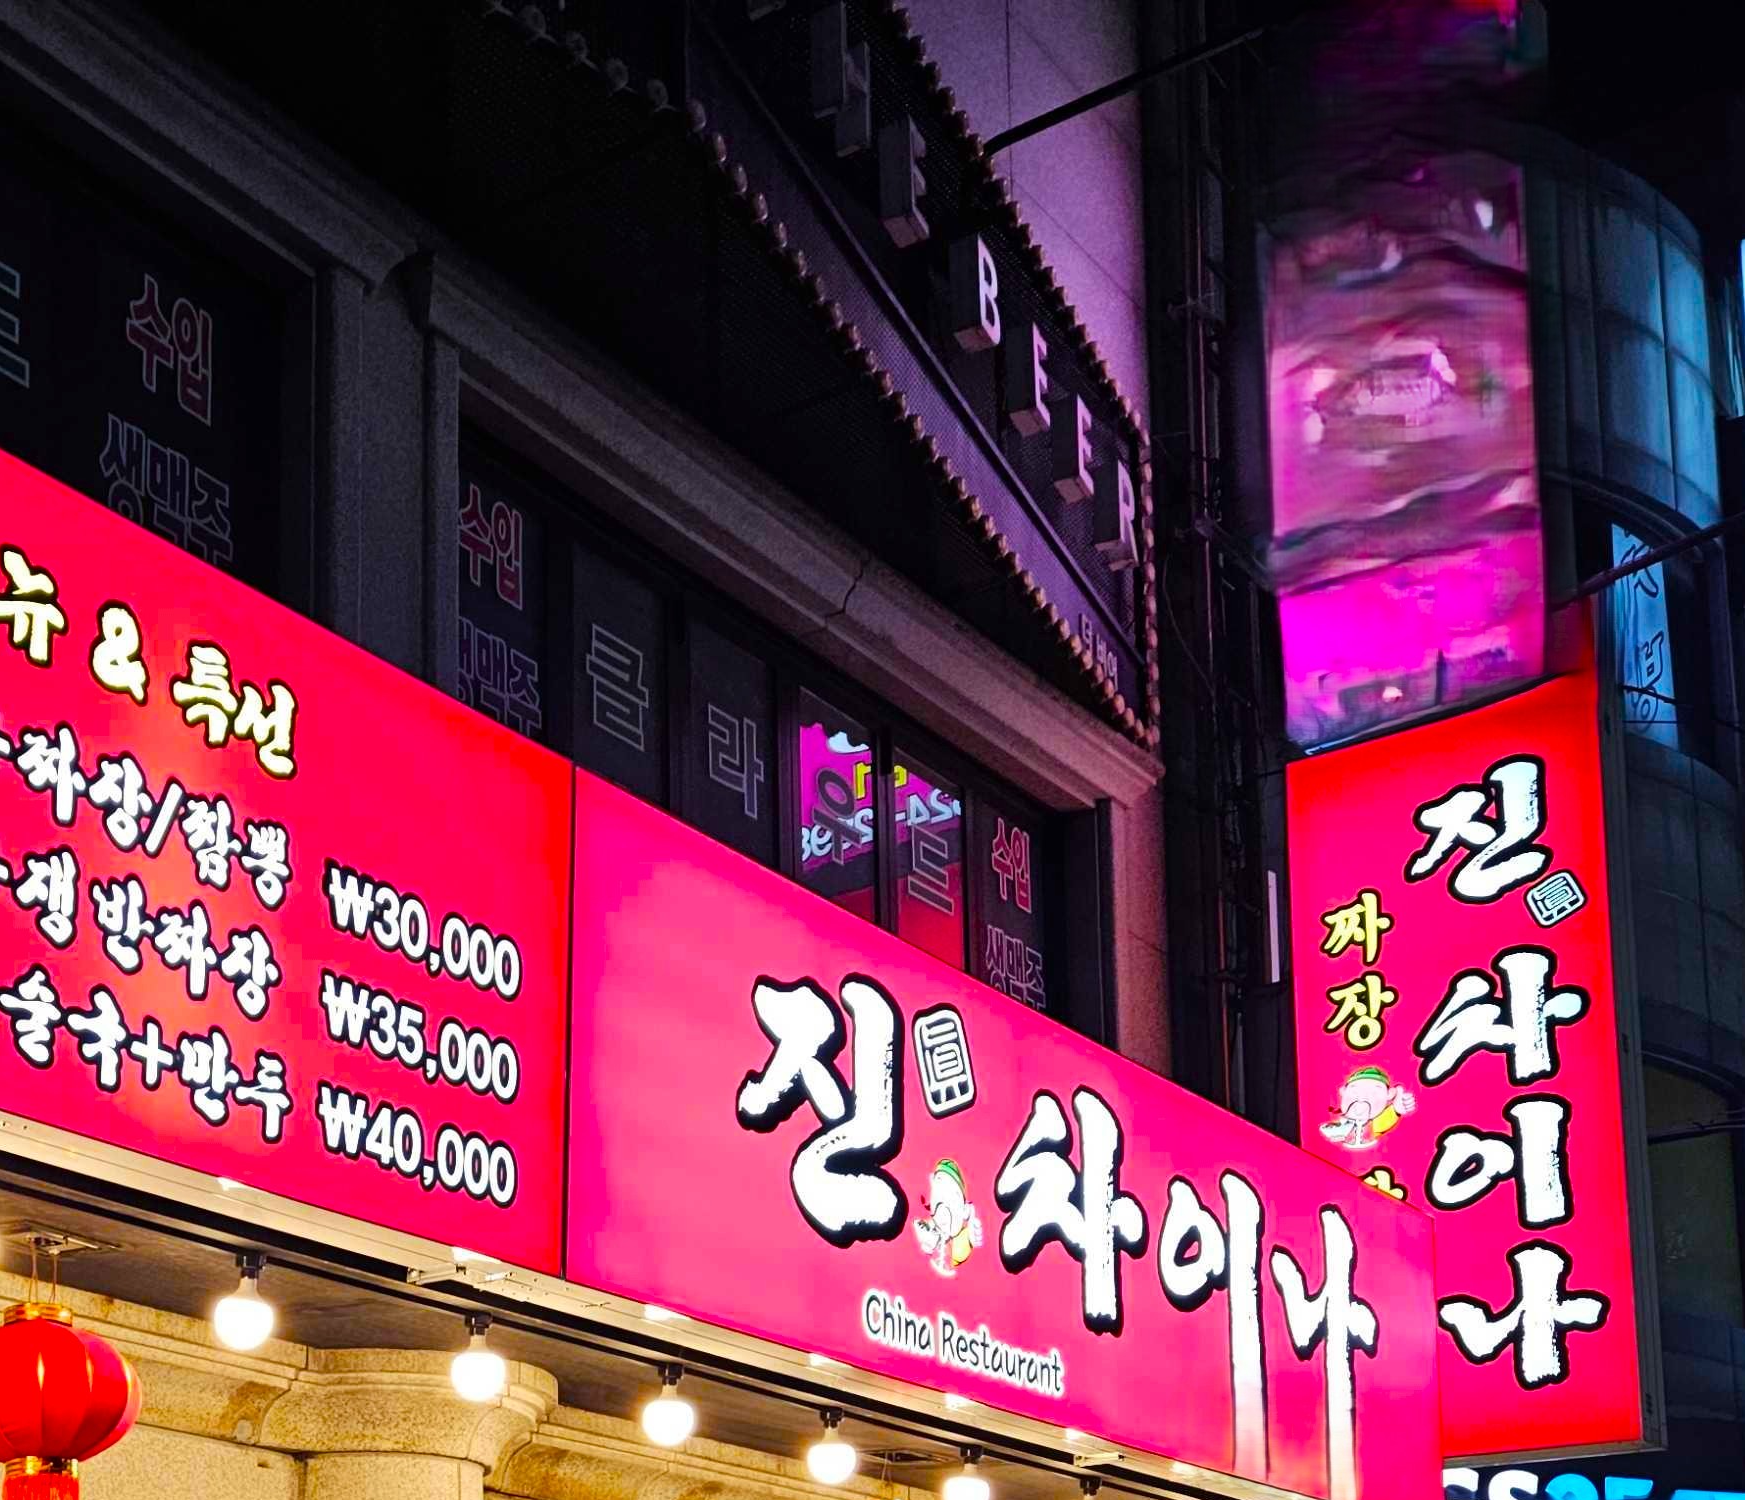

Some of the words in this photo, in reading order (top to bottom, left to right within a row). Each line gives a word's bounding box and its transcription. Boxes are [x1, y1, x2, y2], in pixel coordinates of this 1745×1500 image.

[124, 273, 215, 426] 수입
[457, 483, 524, 611] 수입
[92, 605, 150, 701] &
[172, 645, 298, 778] 특선
[991, 817, 1032, 914] 수입
[325, 866, 522, 998] ₩30,000
[1320, 888, 1398, 1050] 짜장
[319, 972, 520, 1101] ₩35,000
[317, 1084, 517, 1204] ₩40,000
[864, 1290, 934, 1355] China
[938, 1312, 1065, 1396] Restaurant
